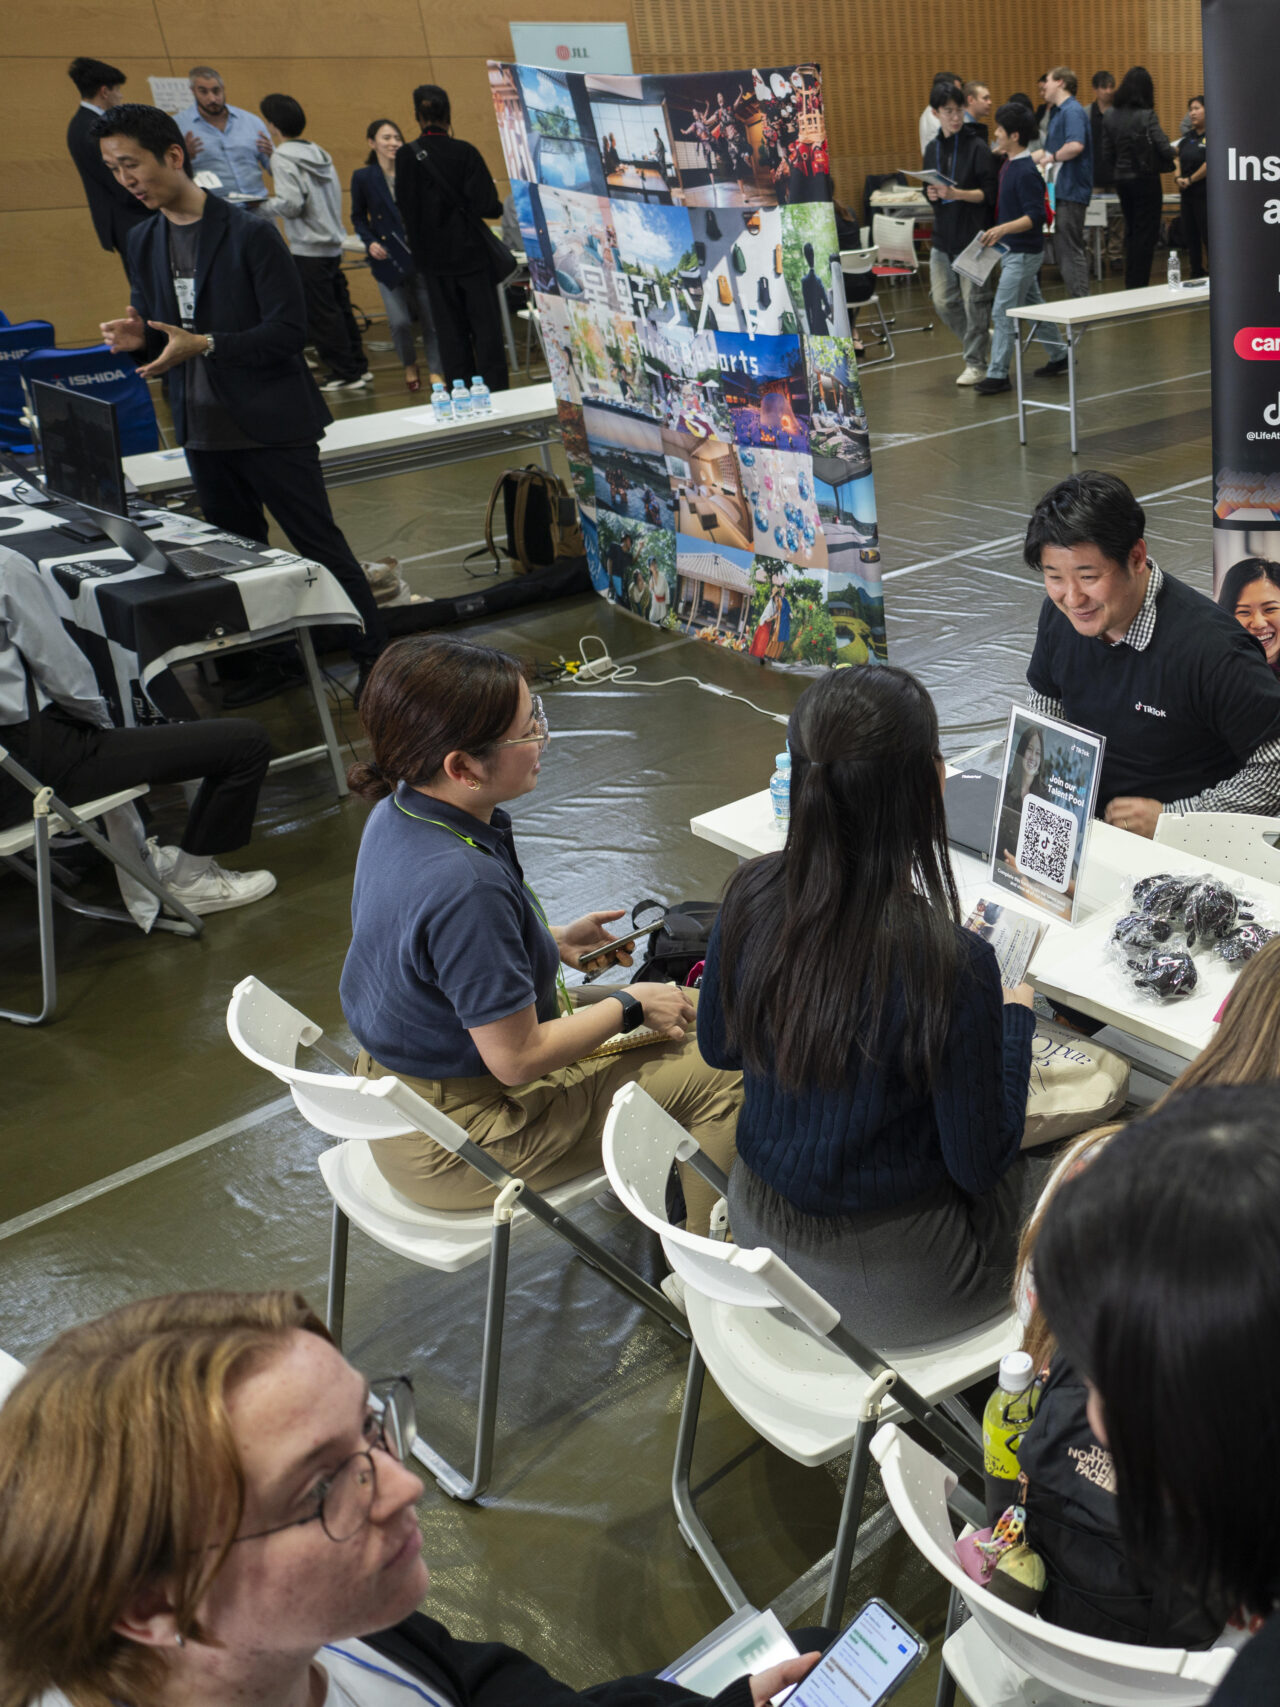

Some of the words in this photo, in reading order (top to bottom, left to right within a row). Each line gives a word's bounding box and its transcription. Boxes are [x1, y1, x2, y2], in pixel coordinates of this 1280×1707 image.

[572, 47, 591, 58] JLL
[68, 369, 126, 387] ISHIDA
[1142, 704, 1167, 718] TikTok
[1049, 774, 1064, 787] Join
[1064, 782, 1077, 792] our
[1048, 784, 1068, 800] Talent
[1068, 794, 1085, 807] Pool
[1067, 1446, 1112, 1475] NORTH
[1089, 1444, 1114, 1463] THE
[1074, 1460, 1106, 1487] FACE
